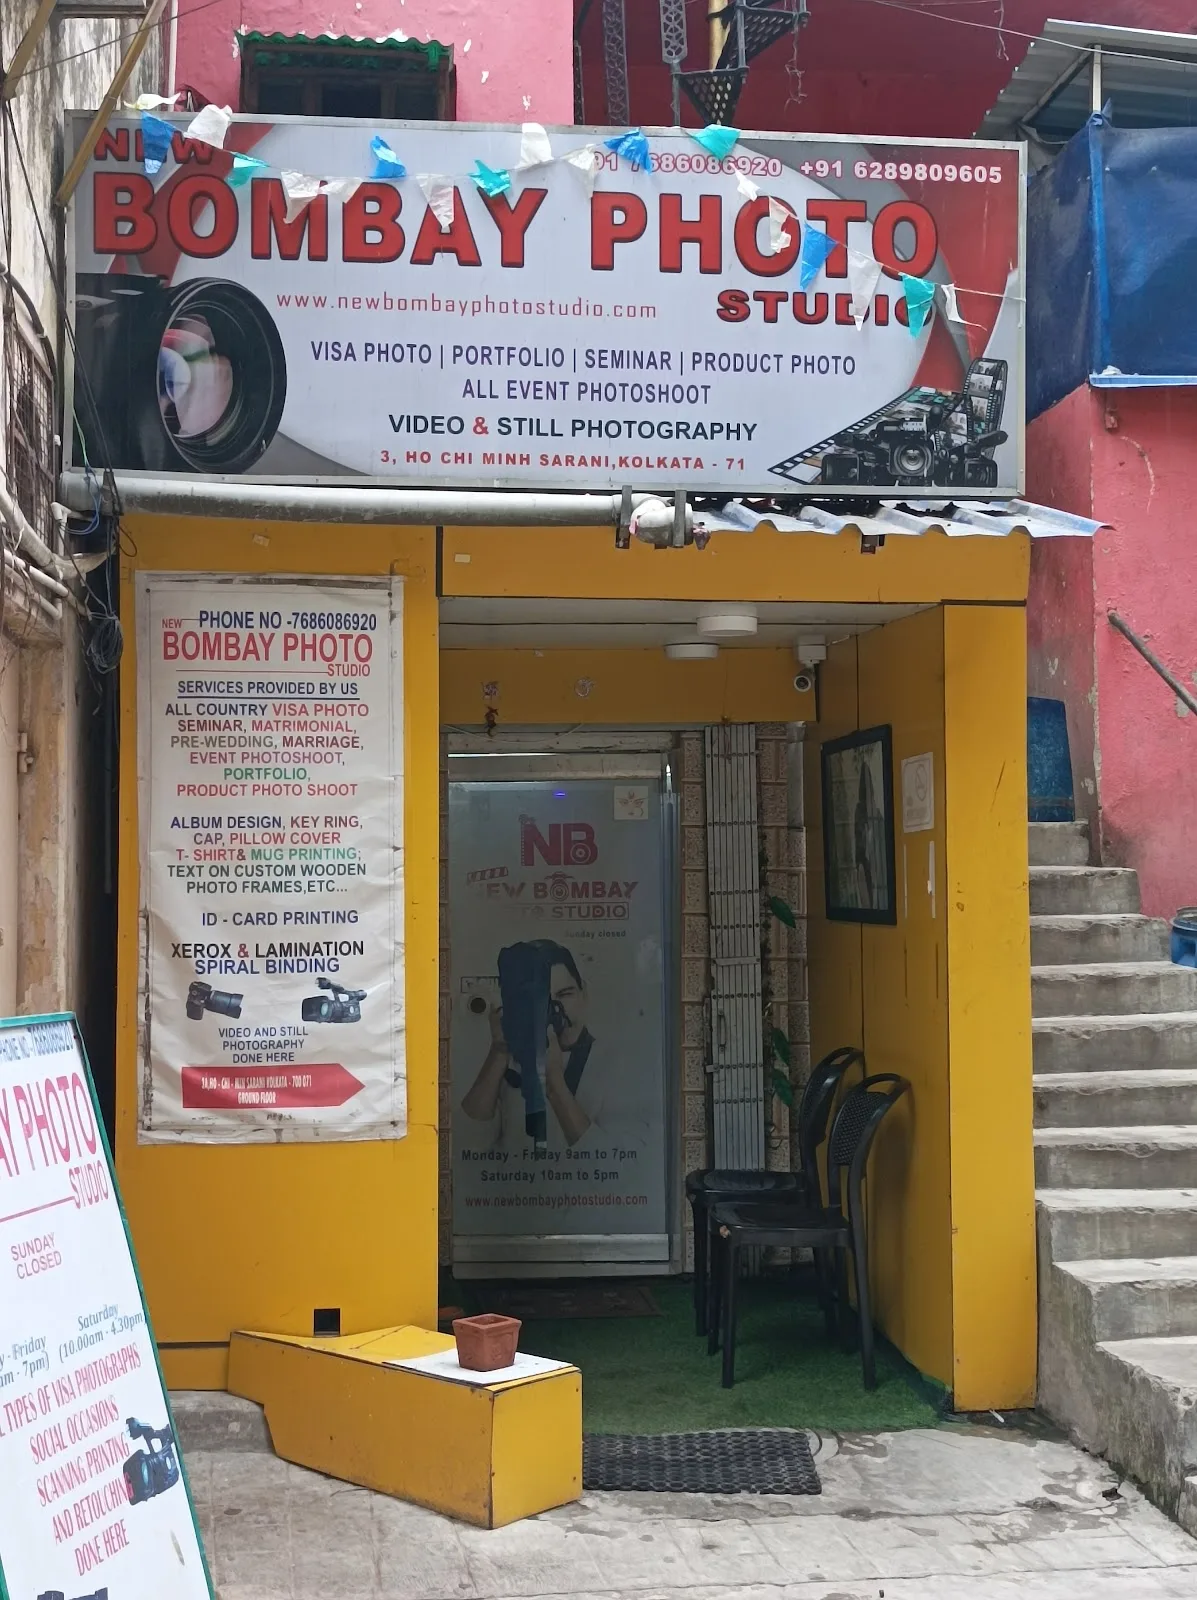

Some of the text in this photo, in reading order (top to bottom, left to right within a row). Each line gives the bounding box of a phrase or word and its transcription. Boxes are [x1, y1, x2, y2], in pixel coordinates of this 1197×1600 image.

[94, 127, 213, 164] NW
[800, 161, 842, 179] +91
[853, 161, 1002, 184] 6289809605
[93, 171, 938, 280] BOMBAY PHOTO
[276, 291, 656, 318] www.newbombayphotostudio.com
[311, 341, 356, 362] VISA
[364, 342, 432, 364] PHOTO
[452, 345, 565, 368] PORTFOLIO
[585, 349, 672, 371] SEMINAR
[692, 352, 783, 374] PRODUCT
[791, 355, 856, 376] PHOTO
[462, 379, 711, 404] ALL EVENT PHOTOSHOOT
[388, 414, 758, 441] VIDEO & STILL PHOTOGRAPHY
[380, 450, 397, 465] 3,
[406, 451, 431, 464] HO
[440, 452, 473, 465] CHI
[482, 453, 530, 466] MINH
[726, 458, 745, 470] 71
[162, 619, 182, 629] NEW
[199, 611, 254, 629] PHONE
[259, 612, 282, 629] NO
[163, 631, 373, 662] BOMBAY PHOTO
[327, 664, 370, 677] STUDIO
[178, 681, 358, 695] SERVICES PROVIDED BY US
[165, 703, 369, 717] ALL COUNTRY VISA PHOTO
[178, 719, 357, 734] SEMINAR, MATRIMONIAL,
[171, 736, 364, 750] PRE-WEDDING, MARRIAGE,
[190, 752, 345, 765] EVENT PHOTOSHOOT,
[224, 768, 311, 782] PORTFOLIO,
[177, 784, 358, 797] PRODUCT PHOTO SHOOT
[170, 815, 363, 830] ALBUM DESIGN, KEY RING,
[193, 832, 341, 846] CAP, PILLOW COVER
[251, 848, 284, 861] MUG
[167, 863, 366, 878] TEXT ON CUSTOM WOODEN
[187, 881, 237, 893] PHOTO
[533, 880, 639, 901] BOMBAY
[202, 912, 217, 926] ID
[232, 911, 278, 926] CARD
[283, 910, 359, 925] PRINTING
[552, 905, 627, 919] STUDIO
[598, 928, 626, 938] closed
[171, 941, 364, 958] XEROX & LAMINATION
[195, 958, 340, 975] SPIRAL BINDING
[219, 1026, 308, 1038] VIDEO AND STILL
[223, 1039, 304, 1051] PHOTOGRAPHY
[232, 1052, 295, 1064] DONE HERE
[238, 1092, 276, 1104] GROUND FLOOR
[13, 1072, 97, 1172] PHOTO
[462, 1149, 509, 1163] Monday
[566, 1148, 590, 1160] 9am
[595, 1148, 607, 1159] to
[612, 1148, 637, 1161] 7pm
[480, 1169, 619, 1183] Saturday 10am to 5pm
[68, 1160, 109, 1209] STUDIO
[465, 1193, 648, 1208] www.newbombayphotostudio.com
[11, 1232, 56, 1261] SUNDAY
[17, 1250, 62, 1280] CLOSED
[78, 1304, 118, 1331] Saturday
[12, 1336, 46, 1360] Friday
[3, 1342, 141, 1432] TYPES OF VISA PHOTOGRAPHS
[29, 1395, 119, 1465] SOCIAL OCCASIONS
[36, 1432, 130, 1507] SCANNING PRINTING
[52, 1472, 134, 1545] AND RETOUCHING
[74, 1519, 130, 1577] DONE HERE
